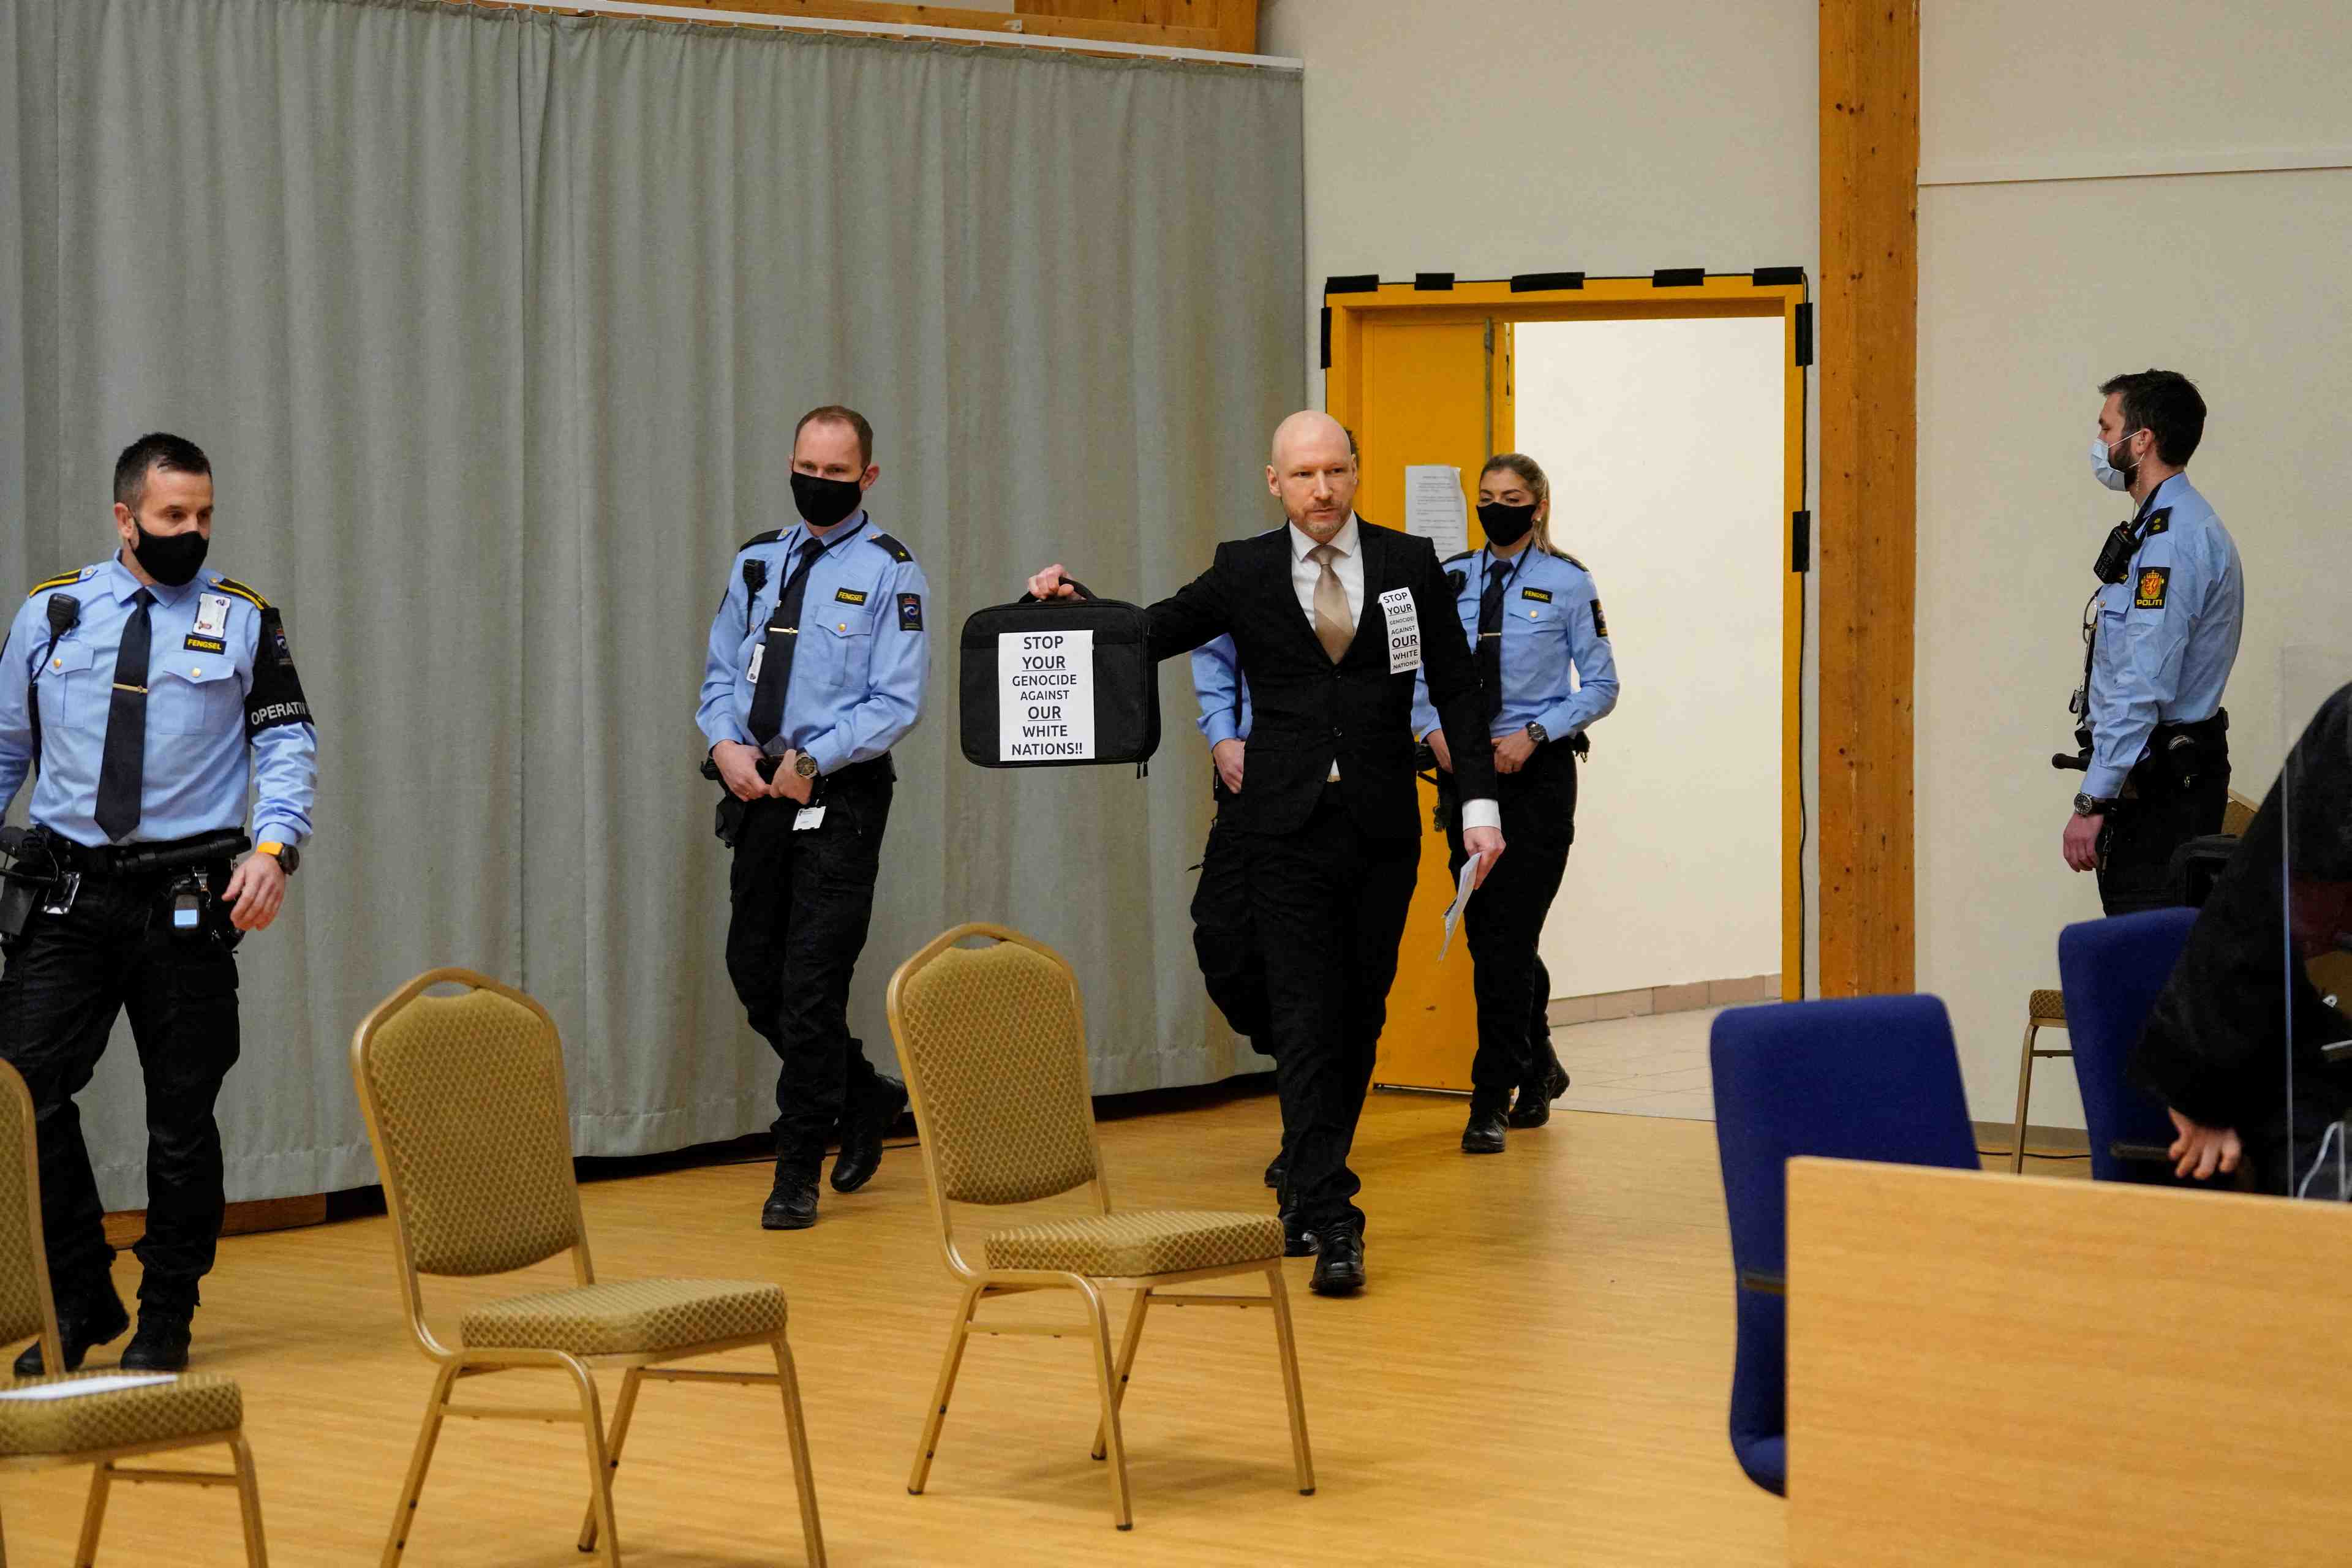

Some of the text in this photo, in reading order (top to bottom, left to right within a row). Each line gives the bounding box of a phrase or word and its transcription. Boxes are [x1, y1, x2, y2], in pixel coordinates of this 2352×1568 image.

[838, 592, 863, 601] FENGSEL
[1383, 592, 1408, 603] STOP
[1387, 604, 1412, 615] YOUR
[1390, 617, 1414, 625] GENOCIDE
[1391, 625, 1415, 635] AGAINST
[187, 638, 222, 650] FENGSEL
[1023, 636, 1064, 649] STOP
[1392, 635, 1417, 648] OUR
[1393, 649, 1418, 660] WHITE
[1022, 655, 1066, 669] YOUR
[1012, 674, 1077, 687] GENOCIDE
[1020, 690, 1070, 701] AGAINST
[1028, 706, 1061, 720] OUR
[1022, 725, 1068, 737] WHITE
[1012, 742, 1083, 756] NATIONS!!
